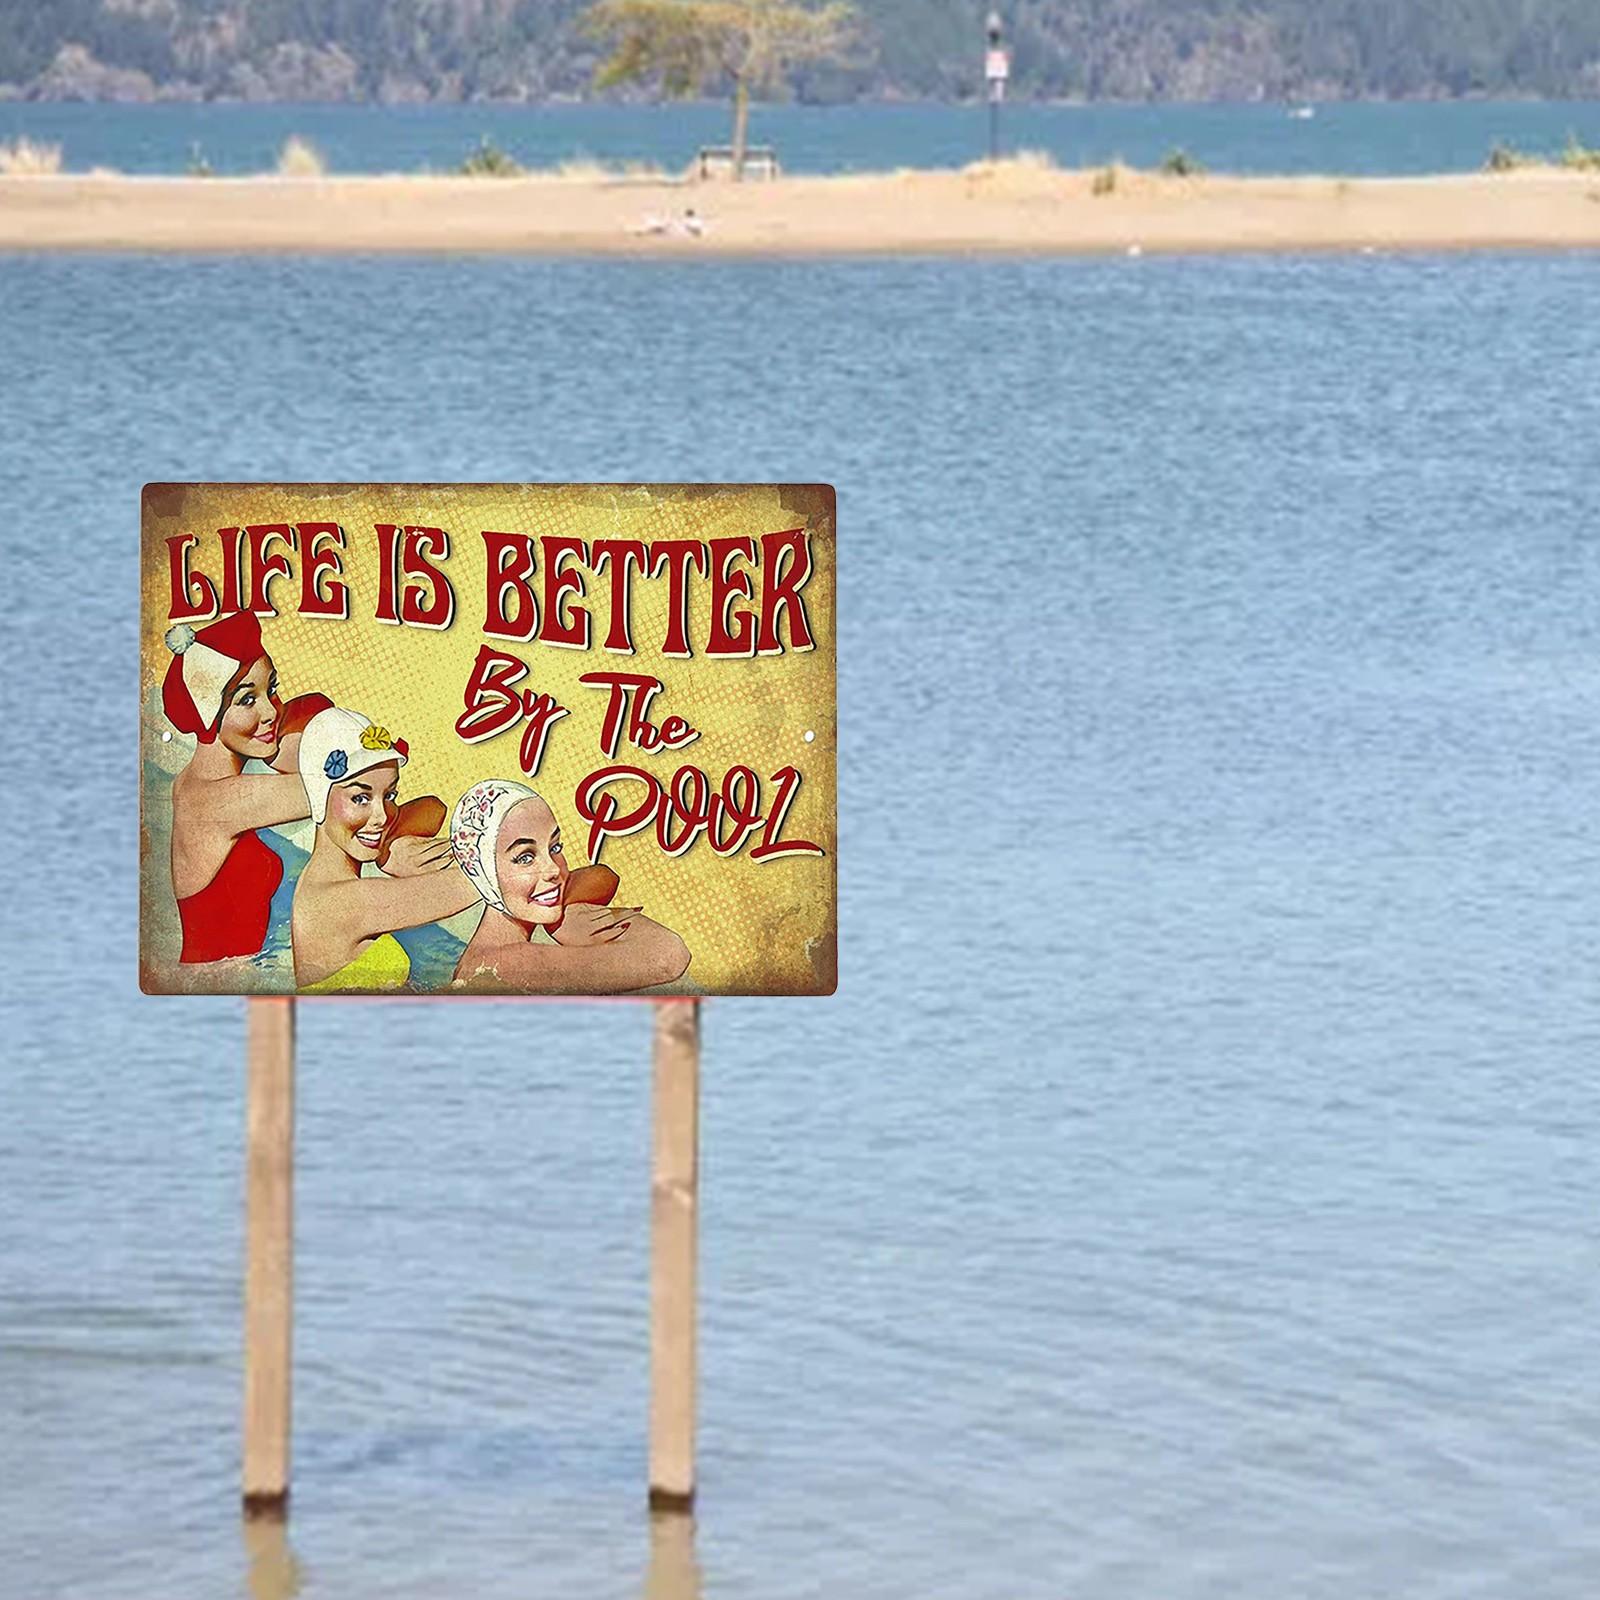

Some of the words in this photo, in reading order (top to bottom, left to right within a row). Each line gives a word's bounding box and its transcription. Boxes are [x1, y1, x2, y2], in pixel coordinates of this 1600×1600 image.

[165, 522, 349, 624] LIFE
[375, 524, 455, 630] IS
[480, 527, 817, 659] BETTER
[455, 644, 567, 776] By
[579, 671, 700, 757] The
[575, 765, 823, 865] POOL
